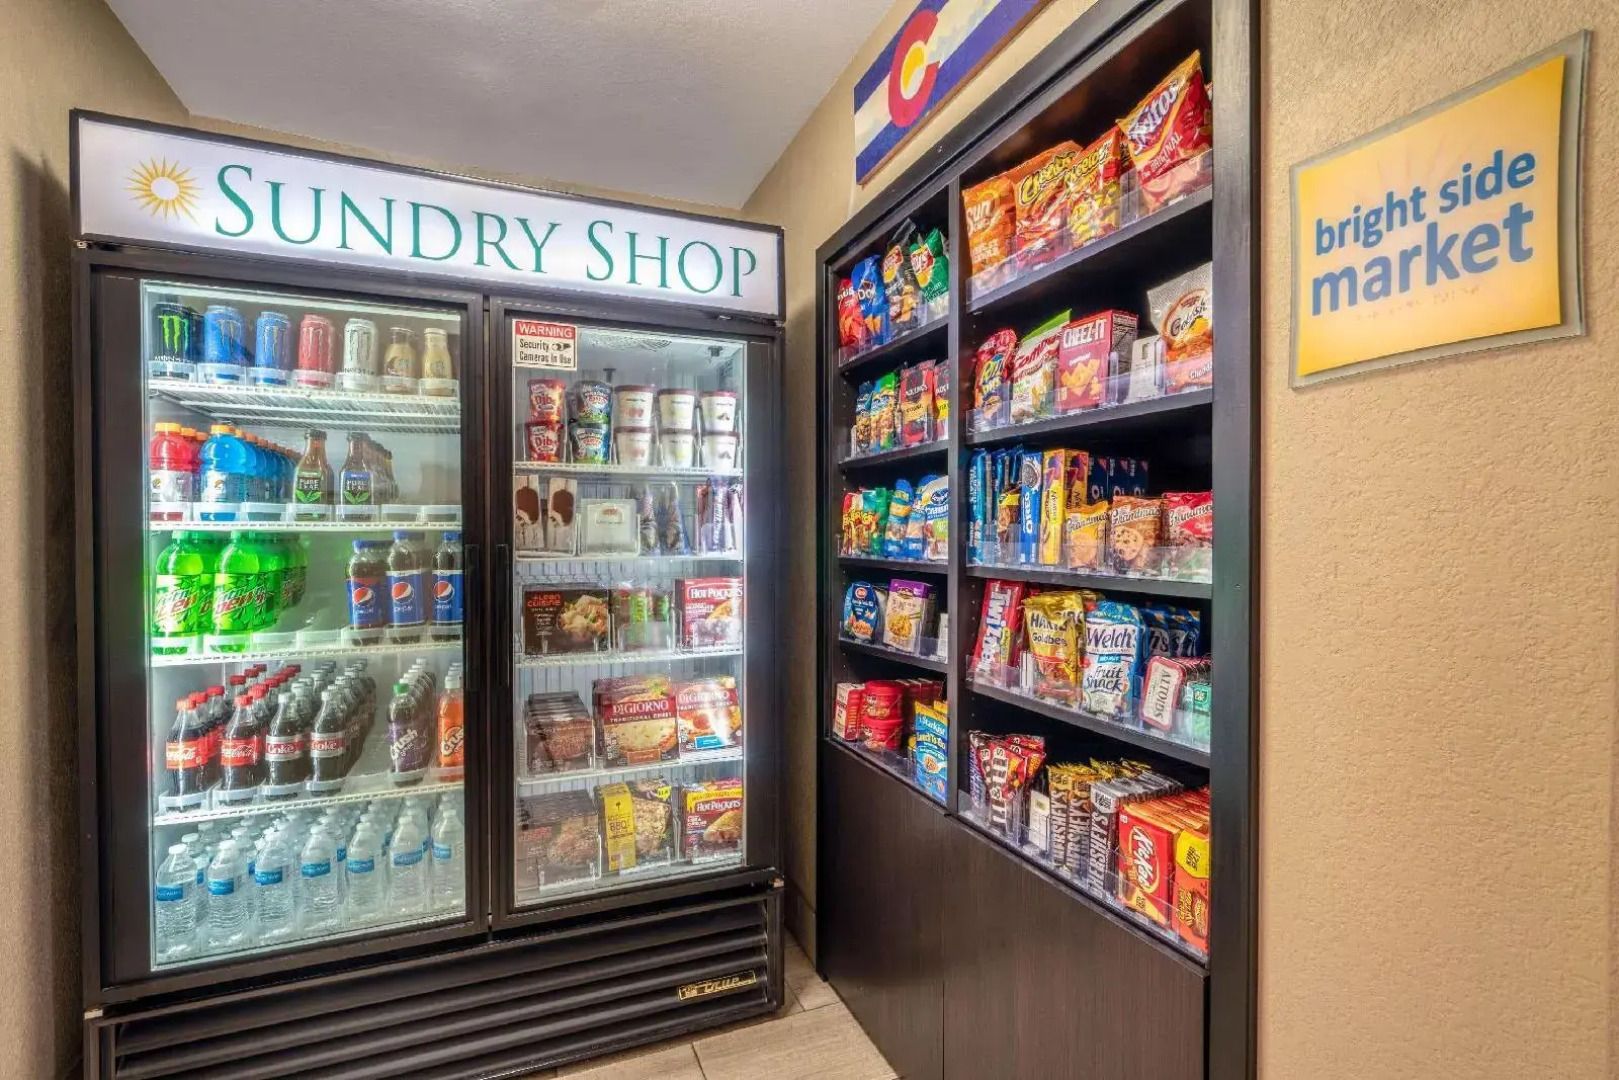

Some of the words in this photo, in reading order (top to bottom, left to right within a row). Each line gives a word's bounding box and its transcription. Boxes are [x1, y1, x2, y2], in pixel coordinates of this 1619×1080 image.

[1315, 184, 1427, 256] bright
[1438, 149, 1536, 214] side
[215, 163, 562, 274] SUNDRY
[586, 219, 757, 297] SHOP
[1311, 201, 1534, 317] market
[519, 323, 573, 338] WARNING
[519, 338, 549, 352] Security
[519, 351, 549, 362] Cameras
[559, 354, 572, 365] Use
[1024, 492, 1033, 534] OREO
[613, 699, 670, 716] DIGIORNO
[1154, 669, 1172, 719] ALTOIDS
